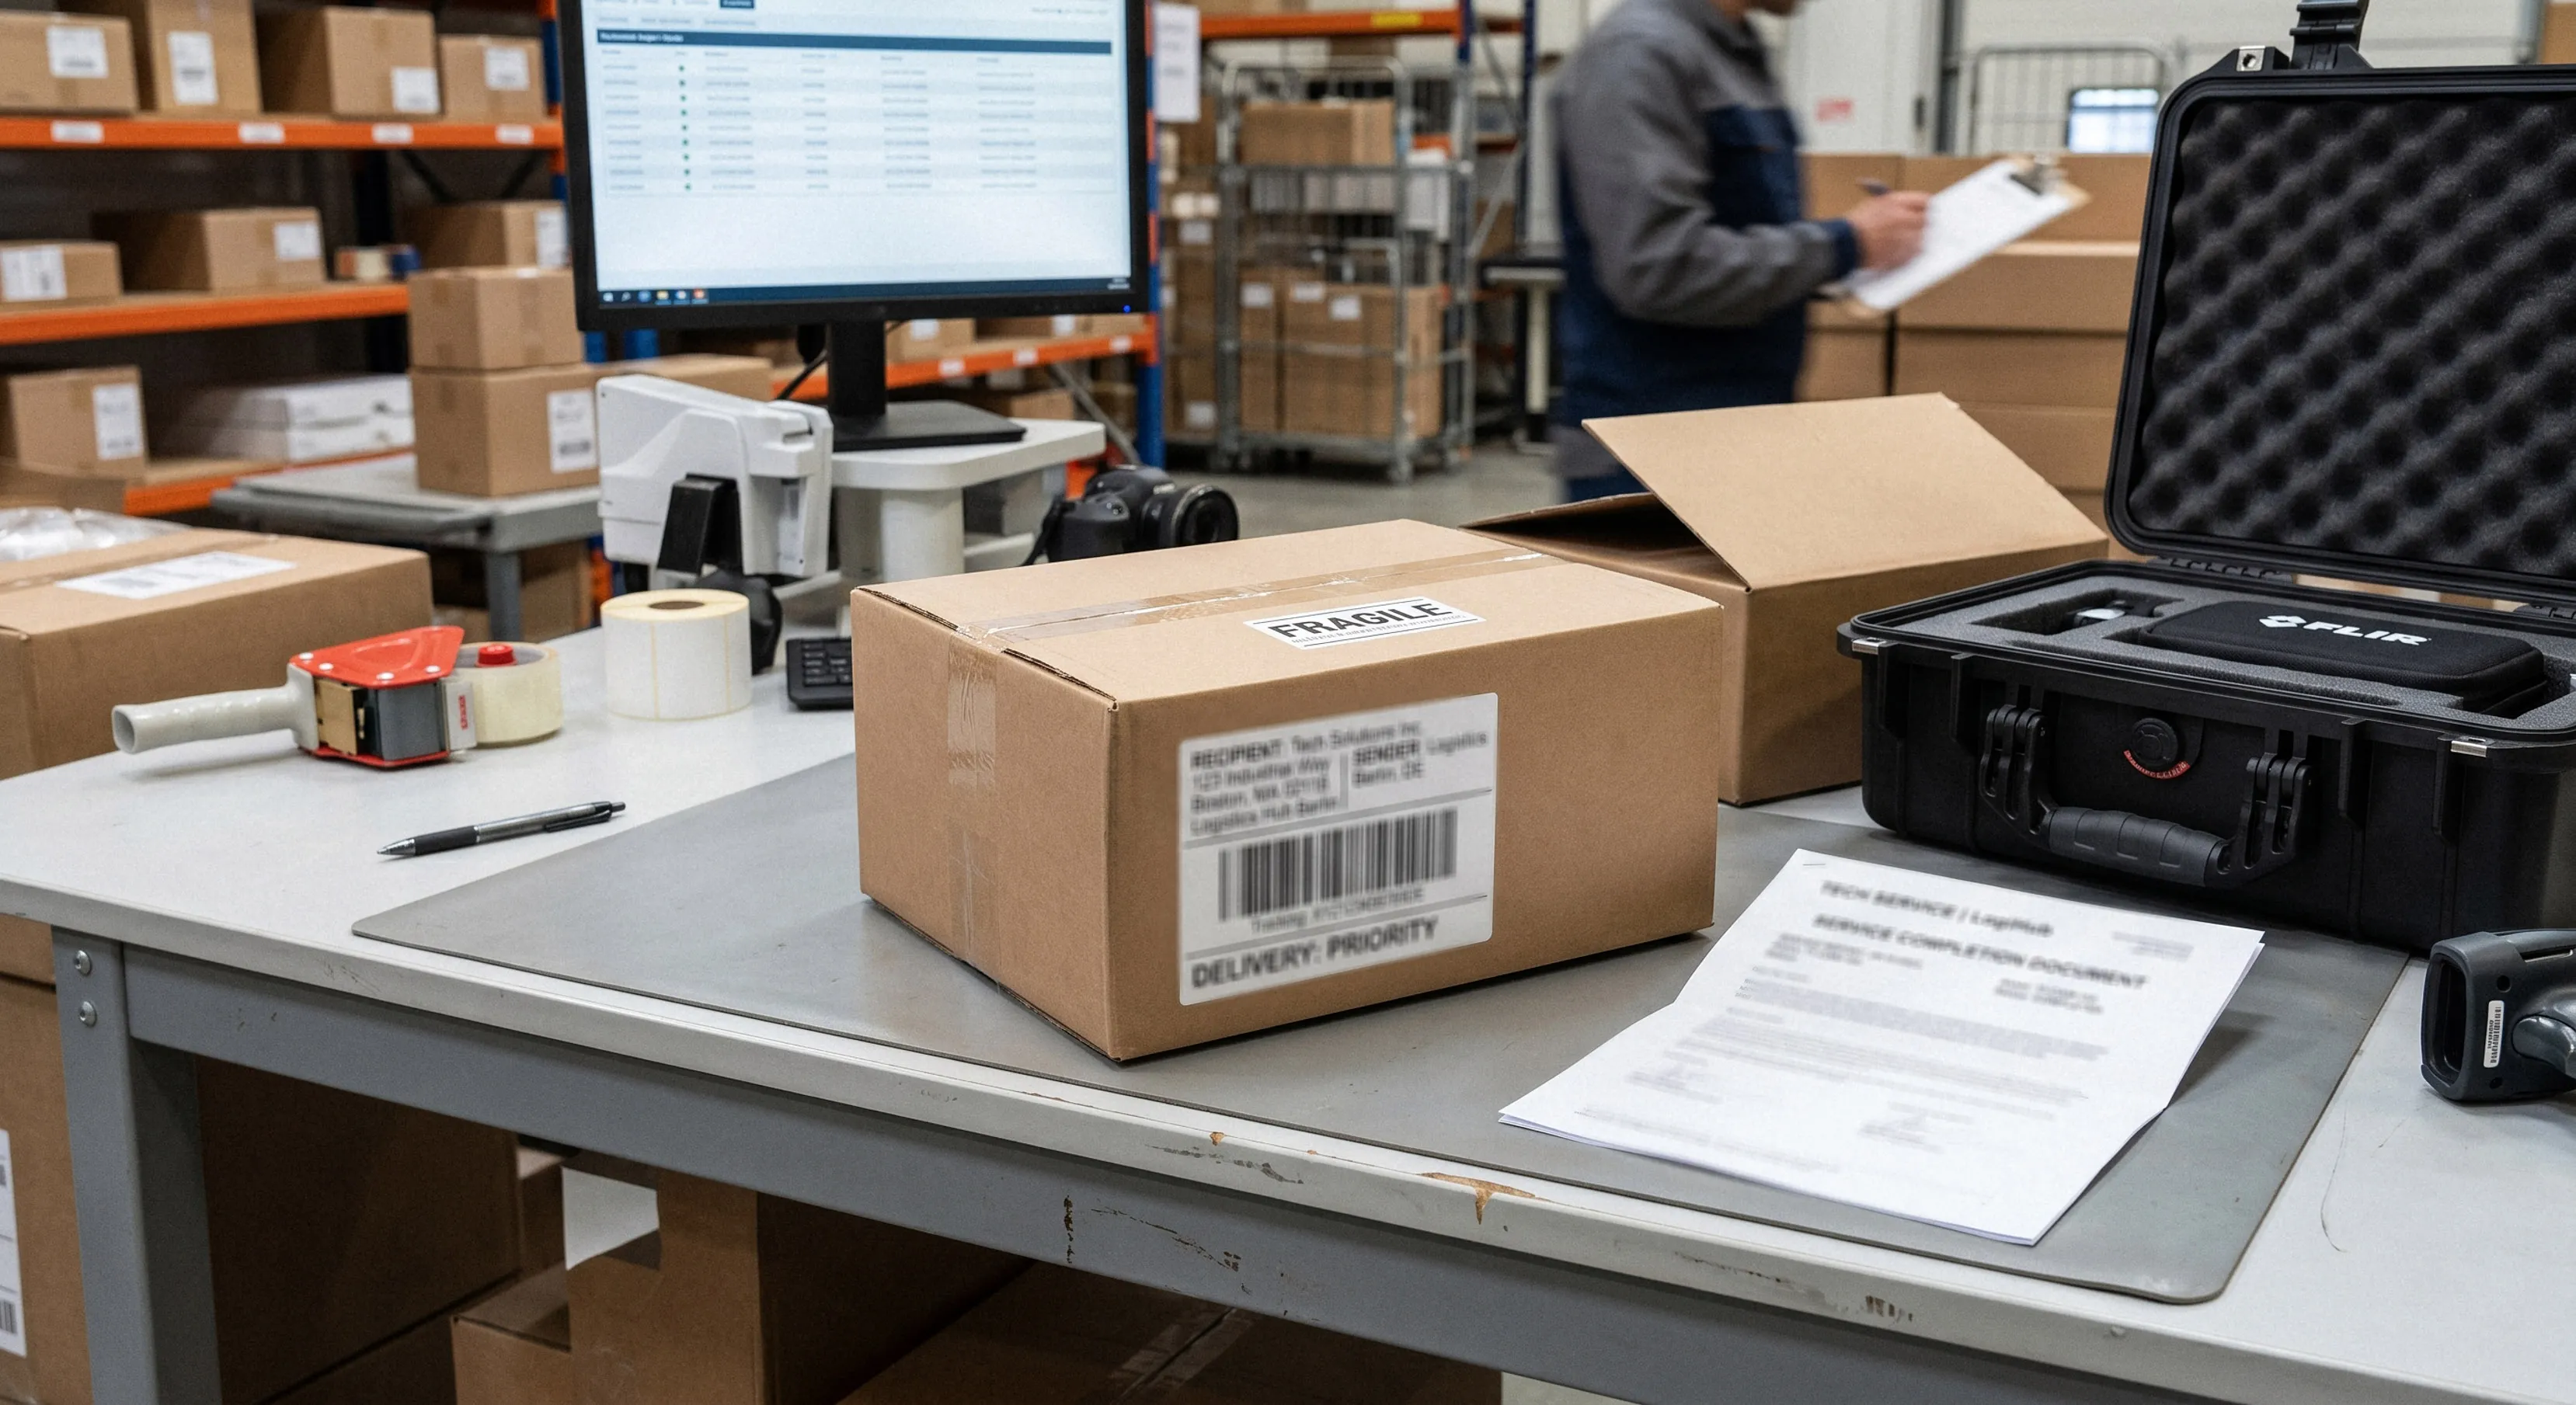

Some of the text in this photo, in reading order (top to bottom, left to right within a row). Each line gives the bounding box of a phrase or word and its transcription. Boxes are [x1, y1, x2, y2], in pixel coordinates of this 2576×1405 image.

[1268, 603, 1453, 638] FRAGILE
[2303, 621, 2428, 645] FLIR
[1192, 916, 1438, 989] DELIVERY: PRIORITY
